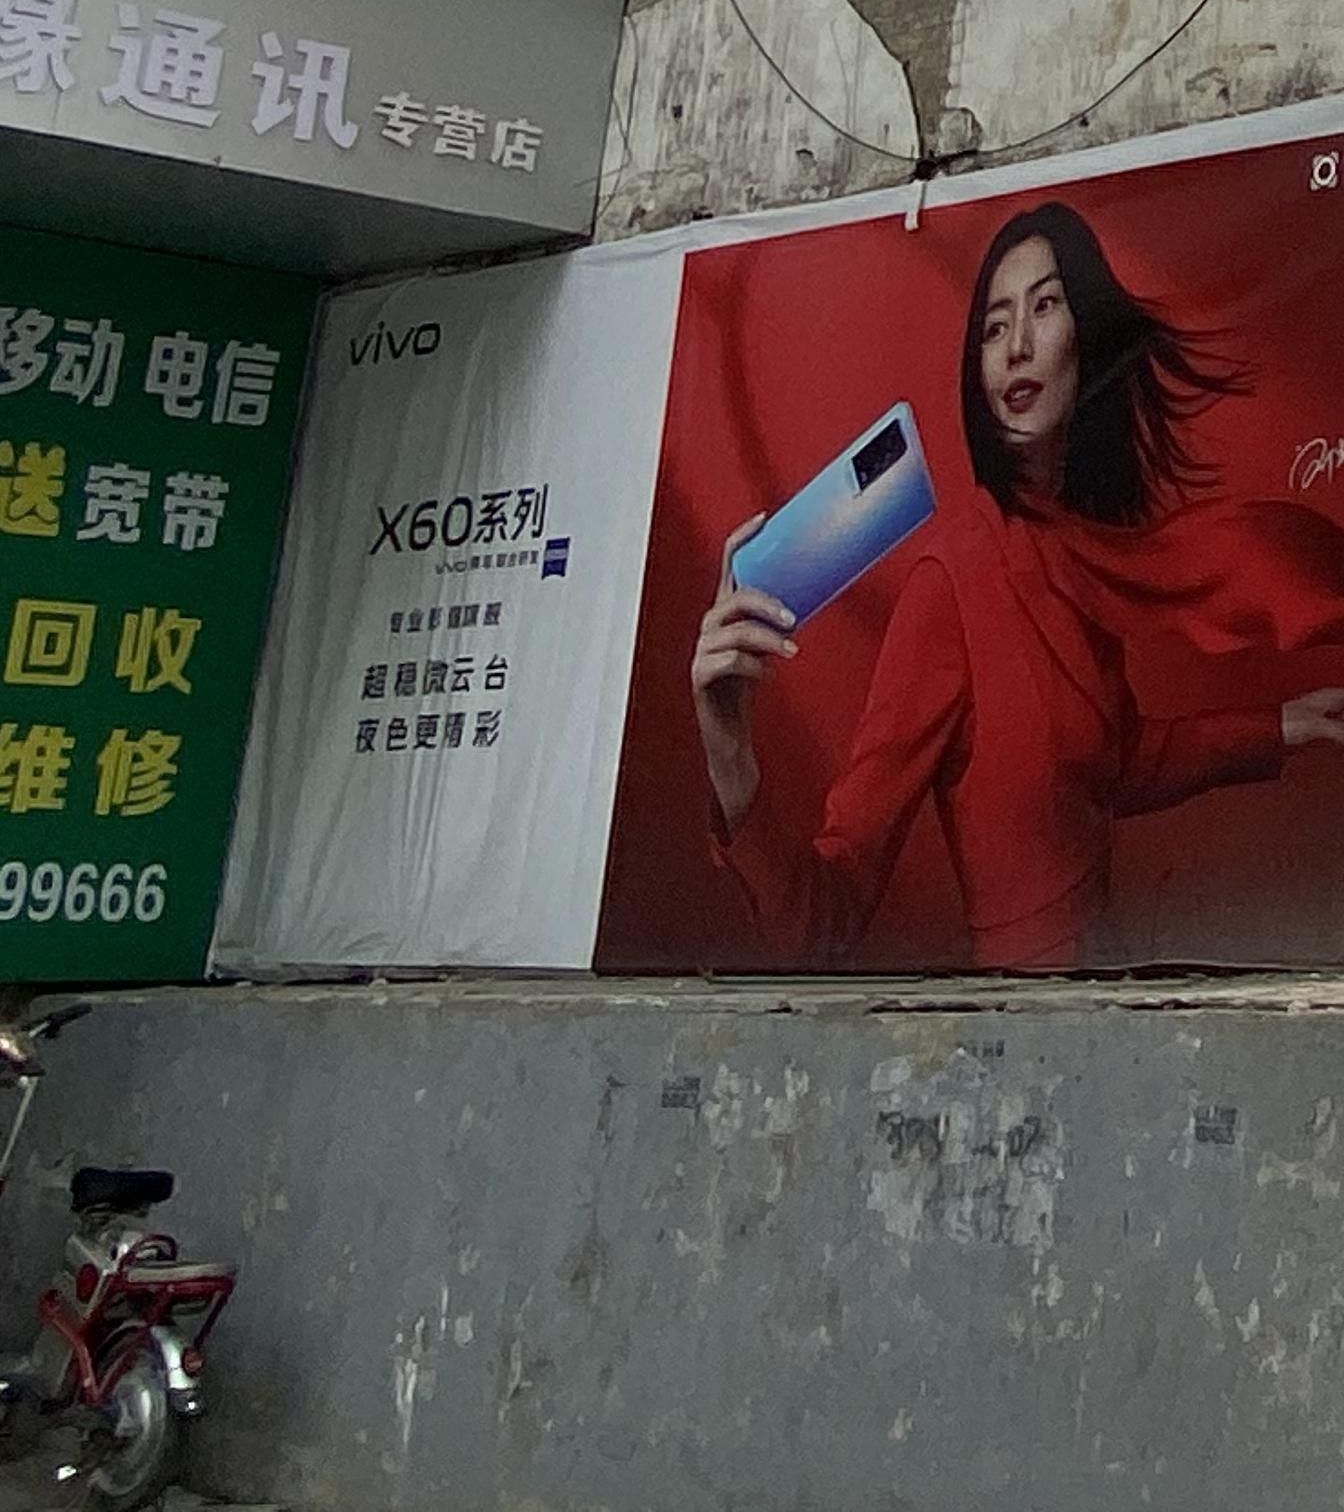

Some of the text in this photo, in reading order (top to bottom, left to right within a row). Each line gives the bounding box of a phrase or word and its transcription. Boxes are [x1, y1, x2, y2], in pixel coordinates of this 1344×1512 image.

[372, 91, 546, 174] 专营店
[146, 331, 280, 426] 电信
[349, 320, 441, 368] vivo
[369, 484, 548, 555] X60系列
[4, 599, 202, 694] 回收
